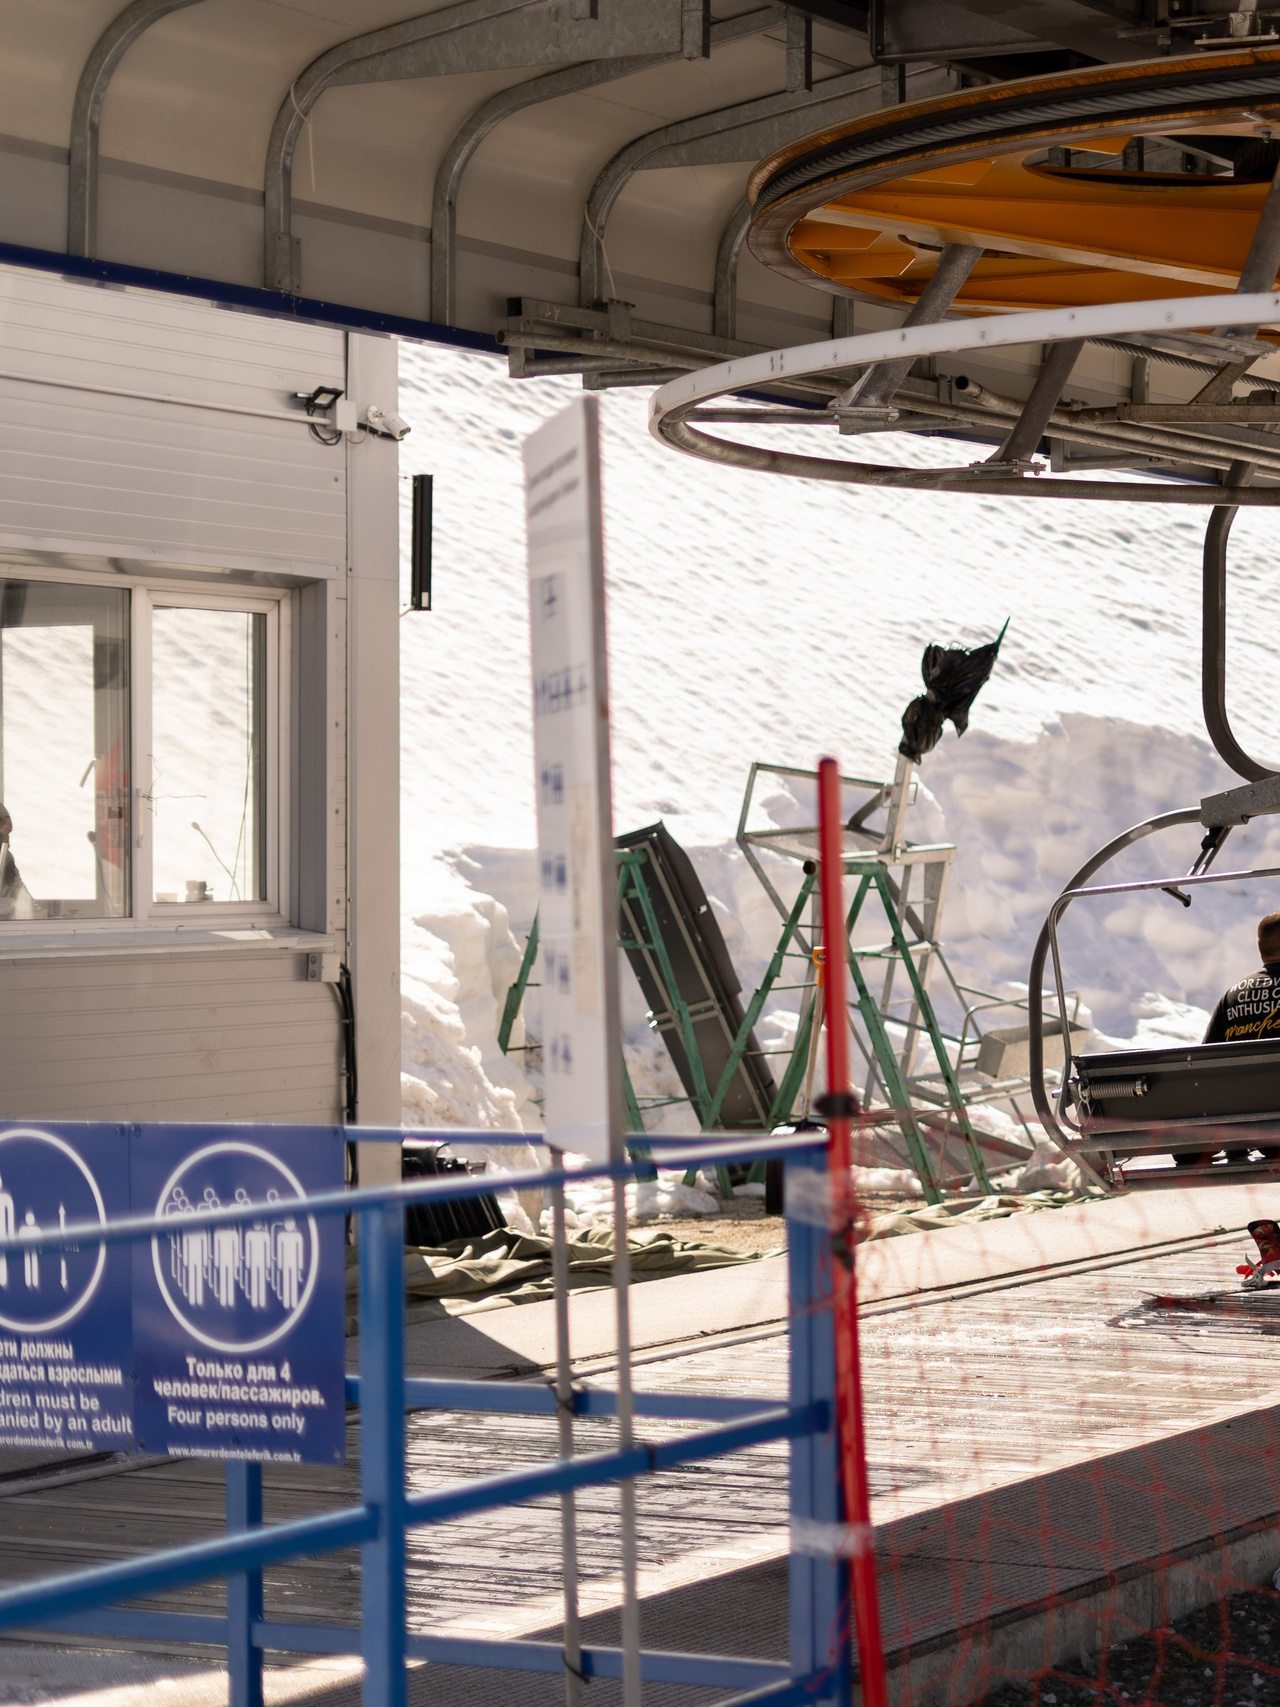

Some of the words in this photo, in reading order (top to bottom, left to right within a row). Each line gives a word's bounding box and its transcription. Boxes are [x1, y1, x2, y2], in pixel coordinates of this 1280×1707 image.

[1237, 989, 1270, 1003] CLUB
[21, 1342, 73, 1361] должны
[0, 1364, 45, 1383] даться
[48, 1366, 122, 1387] взрослыми
[186, 1357, 243, 1379] Только
[246, 1363, 276, 1383] для
[280, 1361, 291, 1381] 4
[36, 1393, 76, 1410] must
[80, 1393, 100, 1411] be
[153, 1379, 325, 1408] человек/пассажиров.
[44, 1412, 63, 1433] by
[68, 1416, 87, 1431] an
[92, 1414, 132, 1434] adult
[168, 1406, 202, 1424] Four
[206, 1411, 268, 1429] persons
[272, 1413, 305, 1434] only
